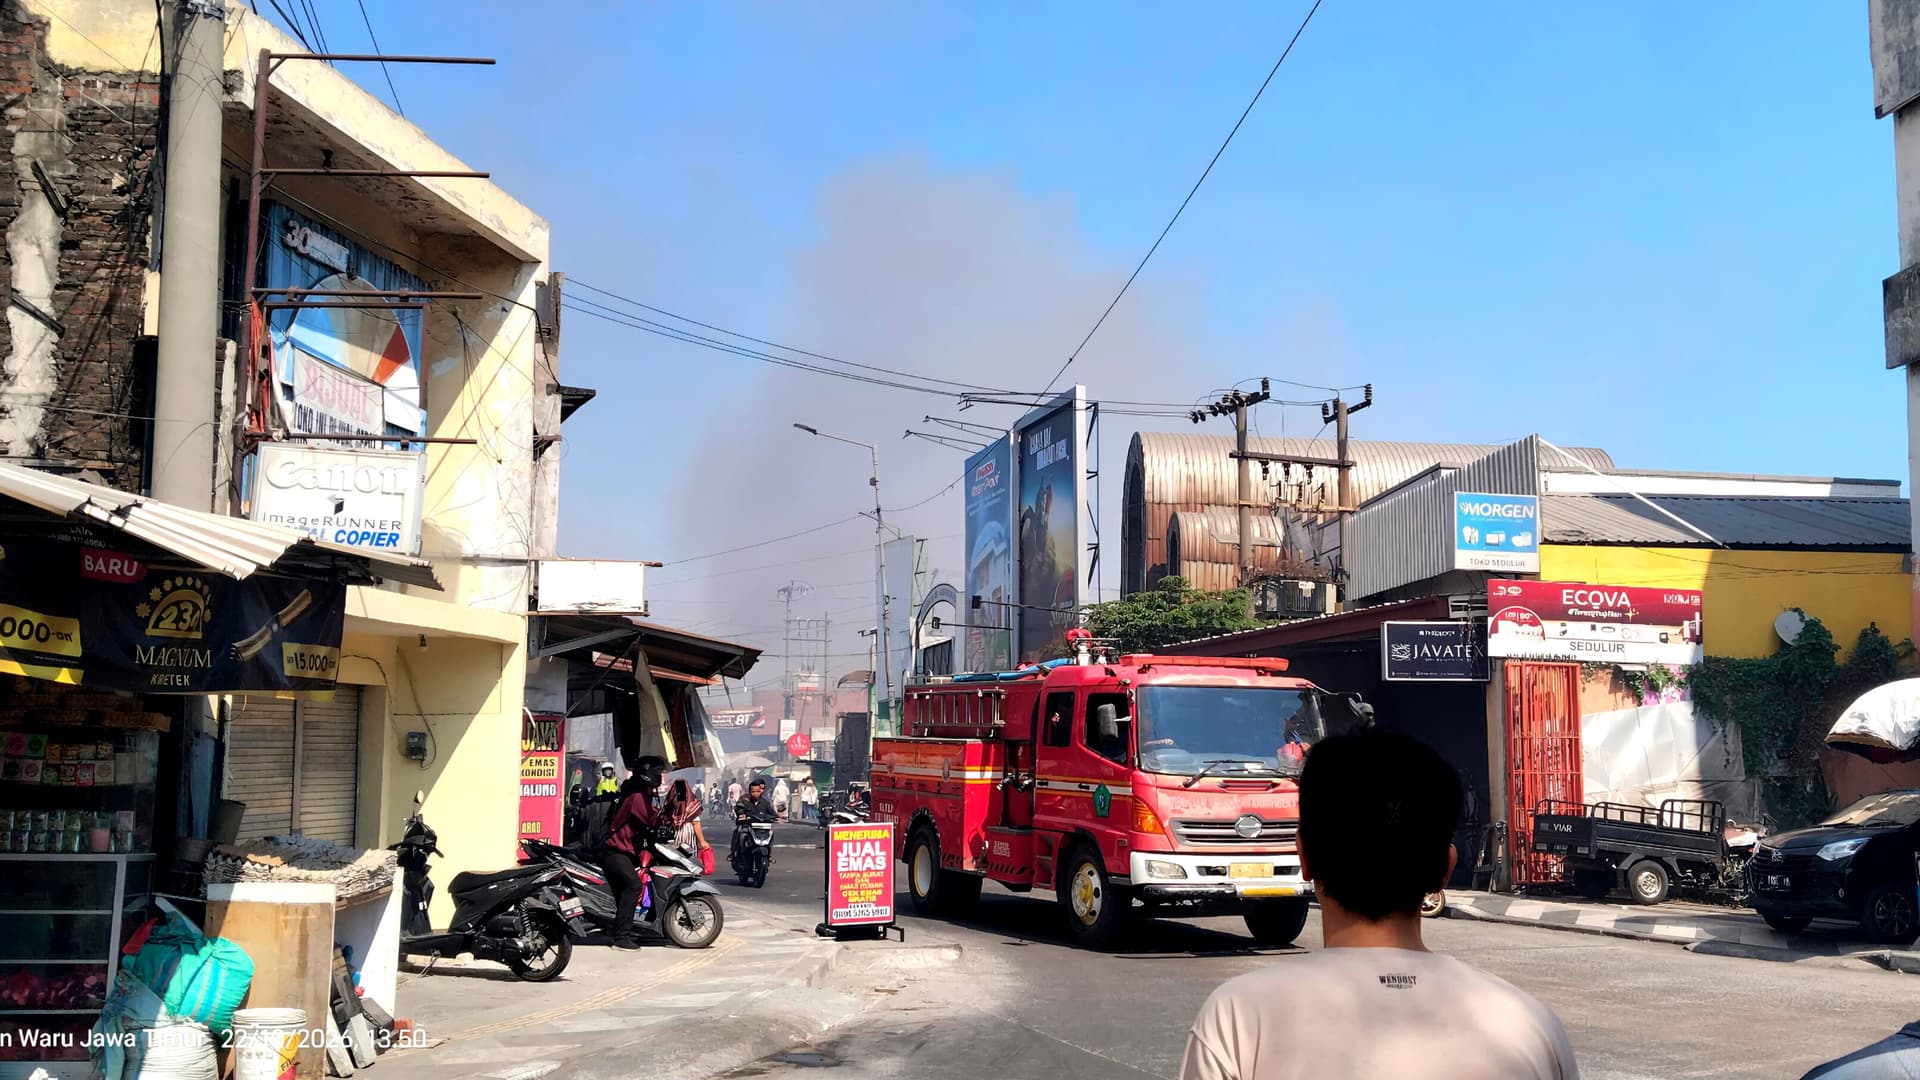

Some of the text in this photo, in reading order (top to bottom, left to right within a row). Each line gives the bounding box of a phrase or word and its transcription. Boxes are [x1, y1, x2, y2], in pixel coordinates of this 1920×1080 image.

[265, 461, 409, 496] Canon
[1465, 503, 1535, 519] MORGEN
[334, 529, 400, 548] COPIER
[84, 555, 138, 577] BARU
[1562, 589, 1631, 609] ECOVA
[1413, 642, 1484, 660] JAVATEX
[1569, 641, 1625, 653] SEDULUR
[135, 644, 213, 669] MAGNUM
[150, 673, 190, 687] KRETEK
[529, 758, 556, 768] EMAS
[833, 830, 890, 841] MENERIMA
[1553, 823, 1573, 833] VIAR
[837, 841, 886, 858] JUAL
[837, 857, 886, 872] EMAS
